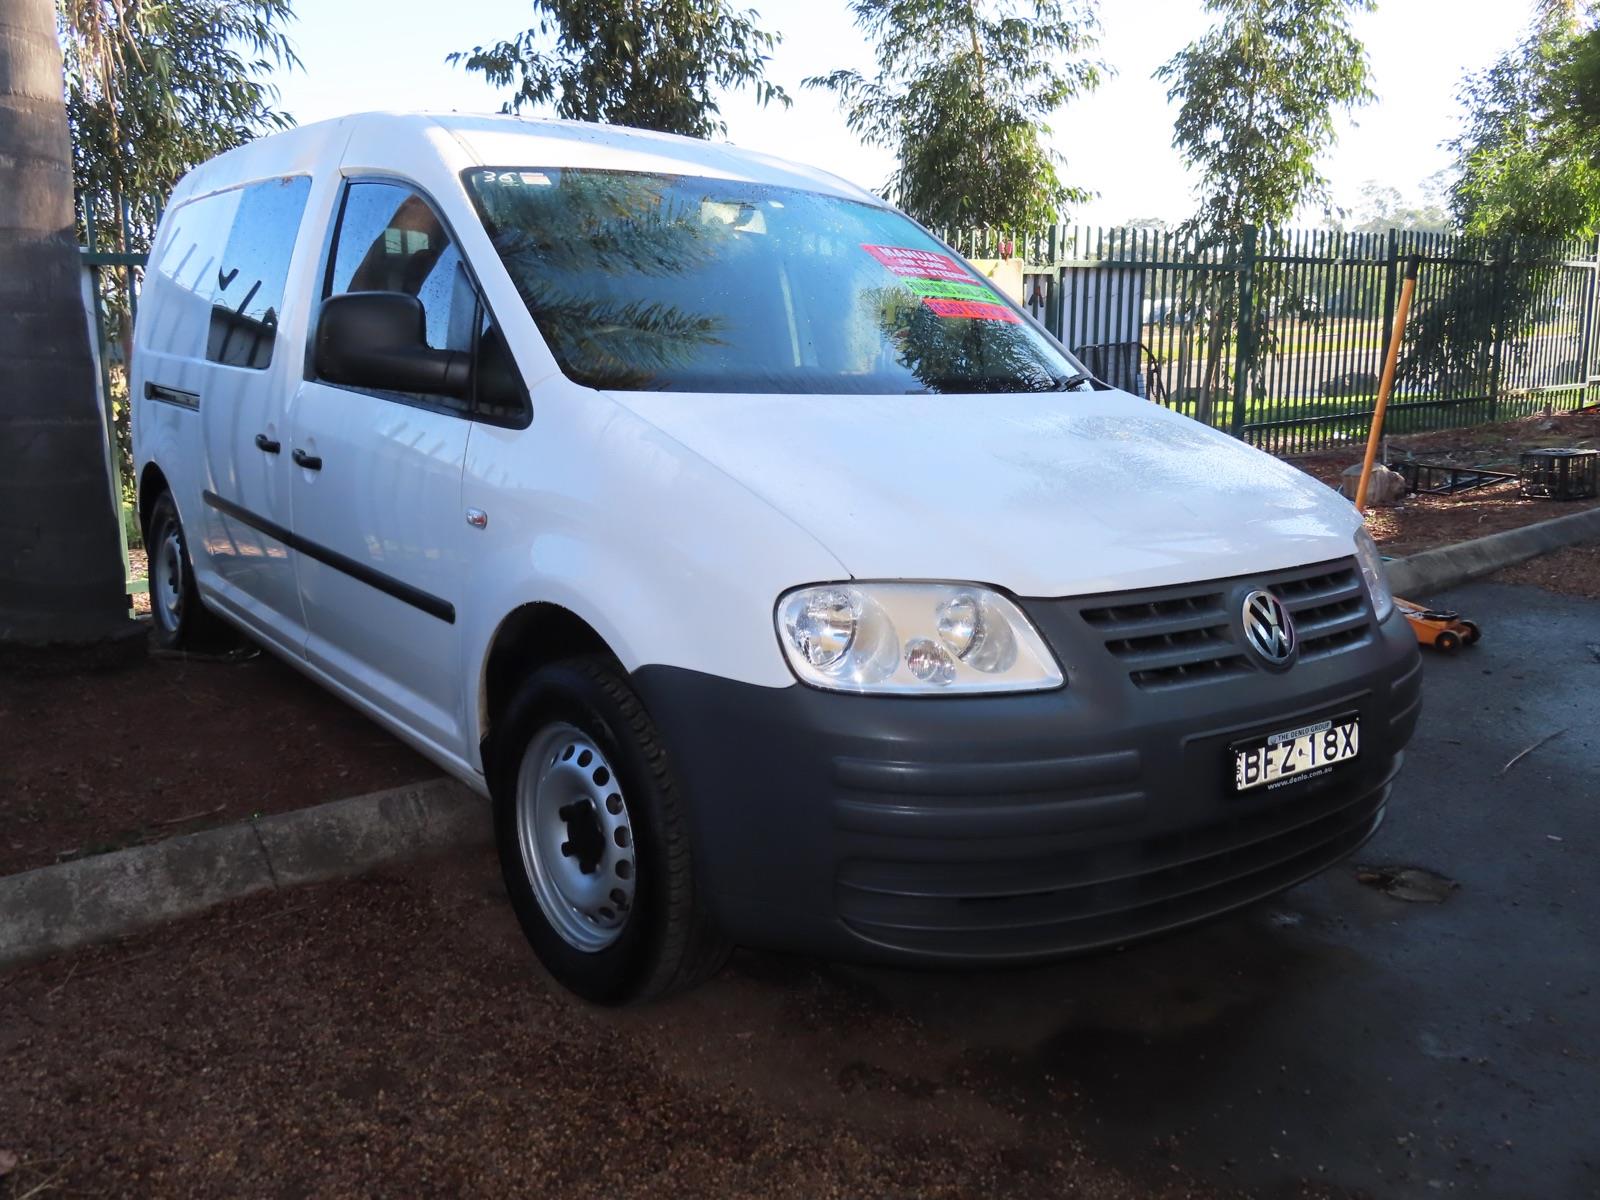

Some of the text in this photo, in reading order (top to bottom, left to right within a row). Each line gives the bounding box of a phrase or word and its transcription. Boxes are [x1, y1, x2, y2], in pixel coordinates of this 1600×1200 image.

[878, 247, 946, 264] MANUAL
[1277, 721, 1331, 742] THE DENLO GROUP
[1267, 767, 1333, 790] www.denlo.com.au
